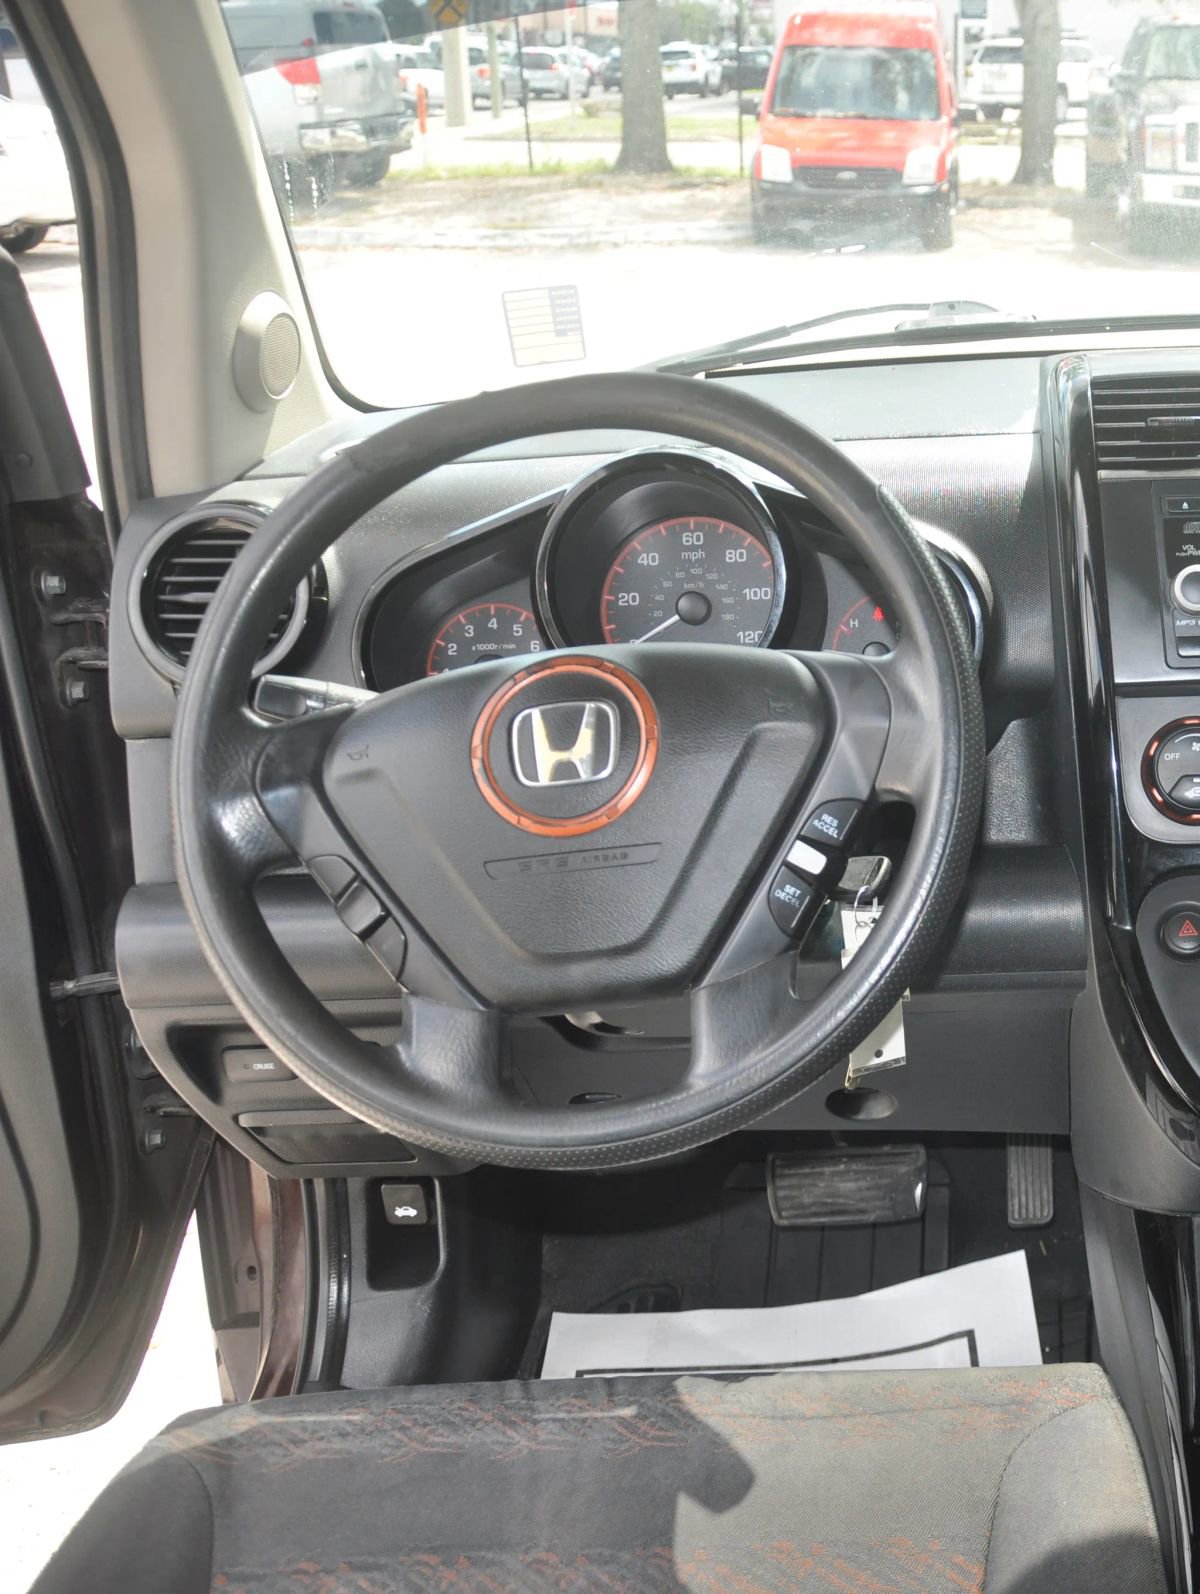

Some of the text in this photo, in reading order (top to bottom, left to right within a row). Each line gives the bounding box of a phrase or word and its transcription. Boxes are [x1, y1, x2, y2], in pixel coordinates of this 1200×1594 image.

[682, 532, 704, 545] 60
[637, 553, 659, 566] 40
[681, 549, 705, 561] mph
[725, 549, 747, 562] 80
[618, 592, 640, 606] 20
[742, 588, 772, 601] 100
[488, 618, 498, 630] 4
[849, 618, 858, 628] H
[464, 625, 474, 637] 3
[512, 624, 523, 637] 5
[447, 643, 457, 655] 2
[530, 640, 540, 652] 6
[1164, 752, 1181, 761] OFF
[821, 813, 840, 828] RES
[812, 819, 839, 839] ACCEL
[783, 884, 801, 897] SET
[774, 889, 801, 909] DECEL
[252, 1062, 275, 1070] CRUISE
